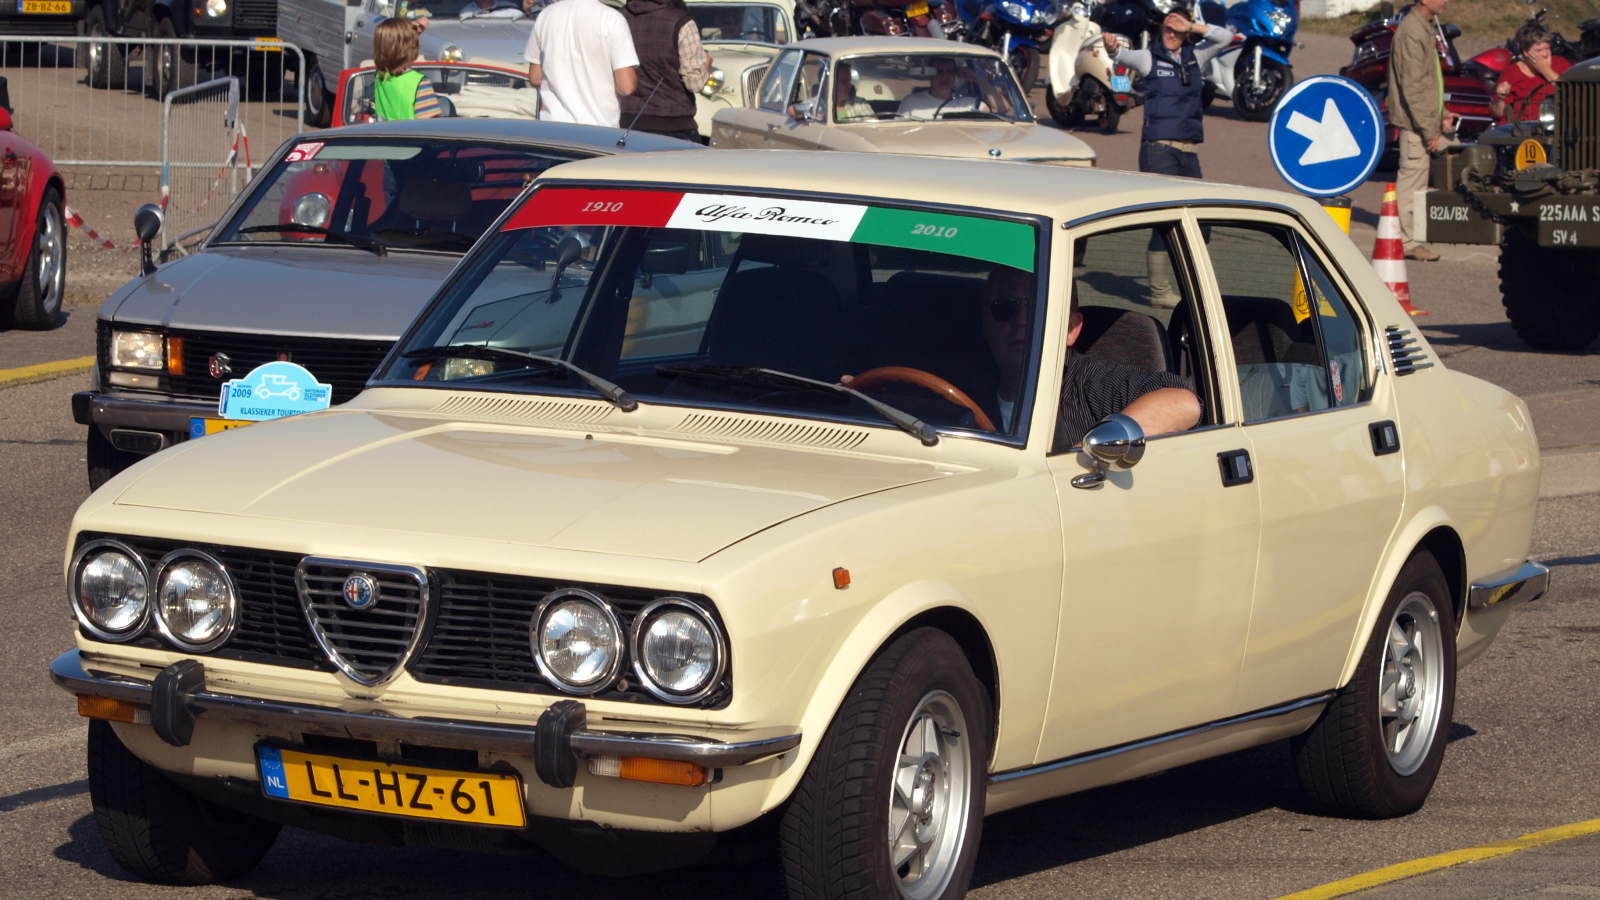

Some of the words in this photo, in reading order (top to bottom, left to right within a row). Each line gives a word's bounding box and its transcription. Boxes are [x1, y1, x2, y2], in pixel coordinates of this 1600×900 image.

[25, 2, 67, 12] ZB-BZ-66
[581, 201, 624, 213] 1910
[694, 203, 753, 223] Alfa
[753, 206, 840, 226] Romeo
[1429, 205, 1469, 221] 82A/BX
[1539, 204, 1588, 222] 225AAA
[911, 223, 958, 239] 2010
[1552, 229, 1567, 244] SV
[1569, 230, 1578, 245] 4
[231, 388, 252, 398] 2009
[240, 407, 276, 416] KLASSIEKER
[266, 775, 285, 789] NL
[305, 760, 496, 817] LL-HZ-61
